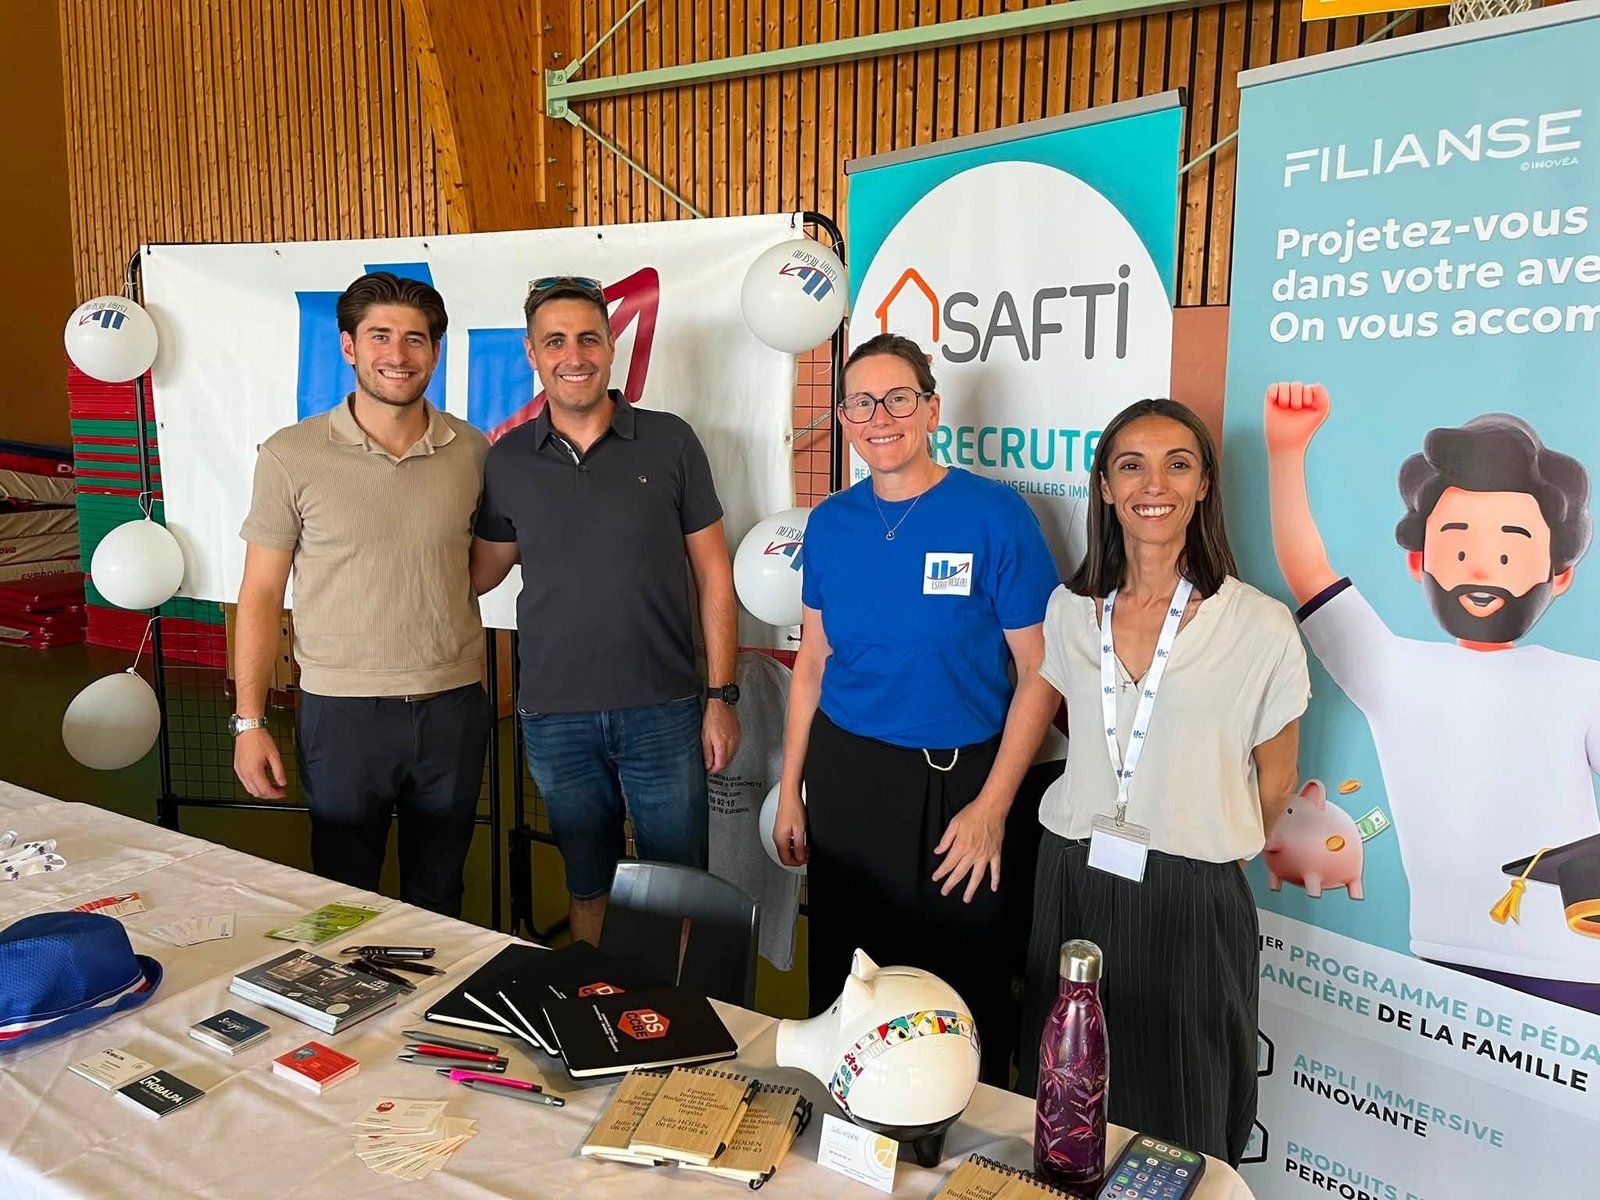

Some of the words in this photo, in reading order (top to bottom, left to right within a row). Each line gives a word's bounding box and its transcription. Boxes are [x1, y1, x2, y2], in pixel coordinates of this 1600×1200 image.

[1284, 109, 1582, 187] FILIANSE
[1276, 206, 1588, 263] Projetez-vous
[1272, 269, 1369, 302] dans
[1381, 259, 1504, 294] votre
[1517, 254, 1600, 286] ave
[1269, 311, 1325, 344] On
[1337, 311, 1438, 340] vous
[640, 1013, 664, 1033] DS
[1290, 944, 1467, 1021] PROGRAMME
[1476, 1006, 1513, 1037] DE
[1521, 1022, 1600, 1066] PÉDA
[1378, 1003, 1413, 1032] DE
[1419, 1017, 1454, 1046] LA
[1461, 1031, 1588, 1092] FAMILLE
[1292, 1071, 1427, 1138] INNOVANTE
[1293, 1054, 1357, 1091] APPLI
[1365, 1082, 1505, 1148] IMMERSIVE
[1287, 1141, 1398, 1200] PRODUITS
